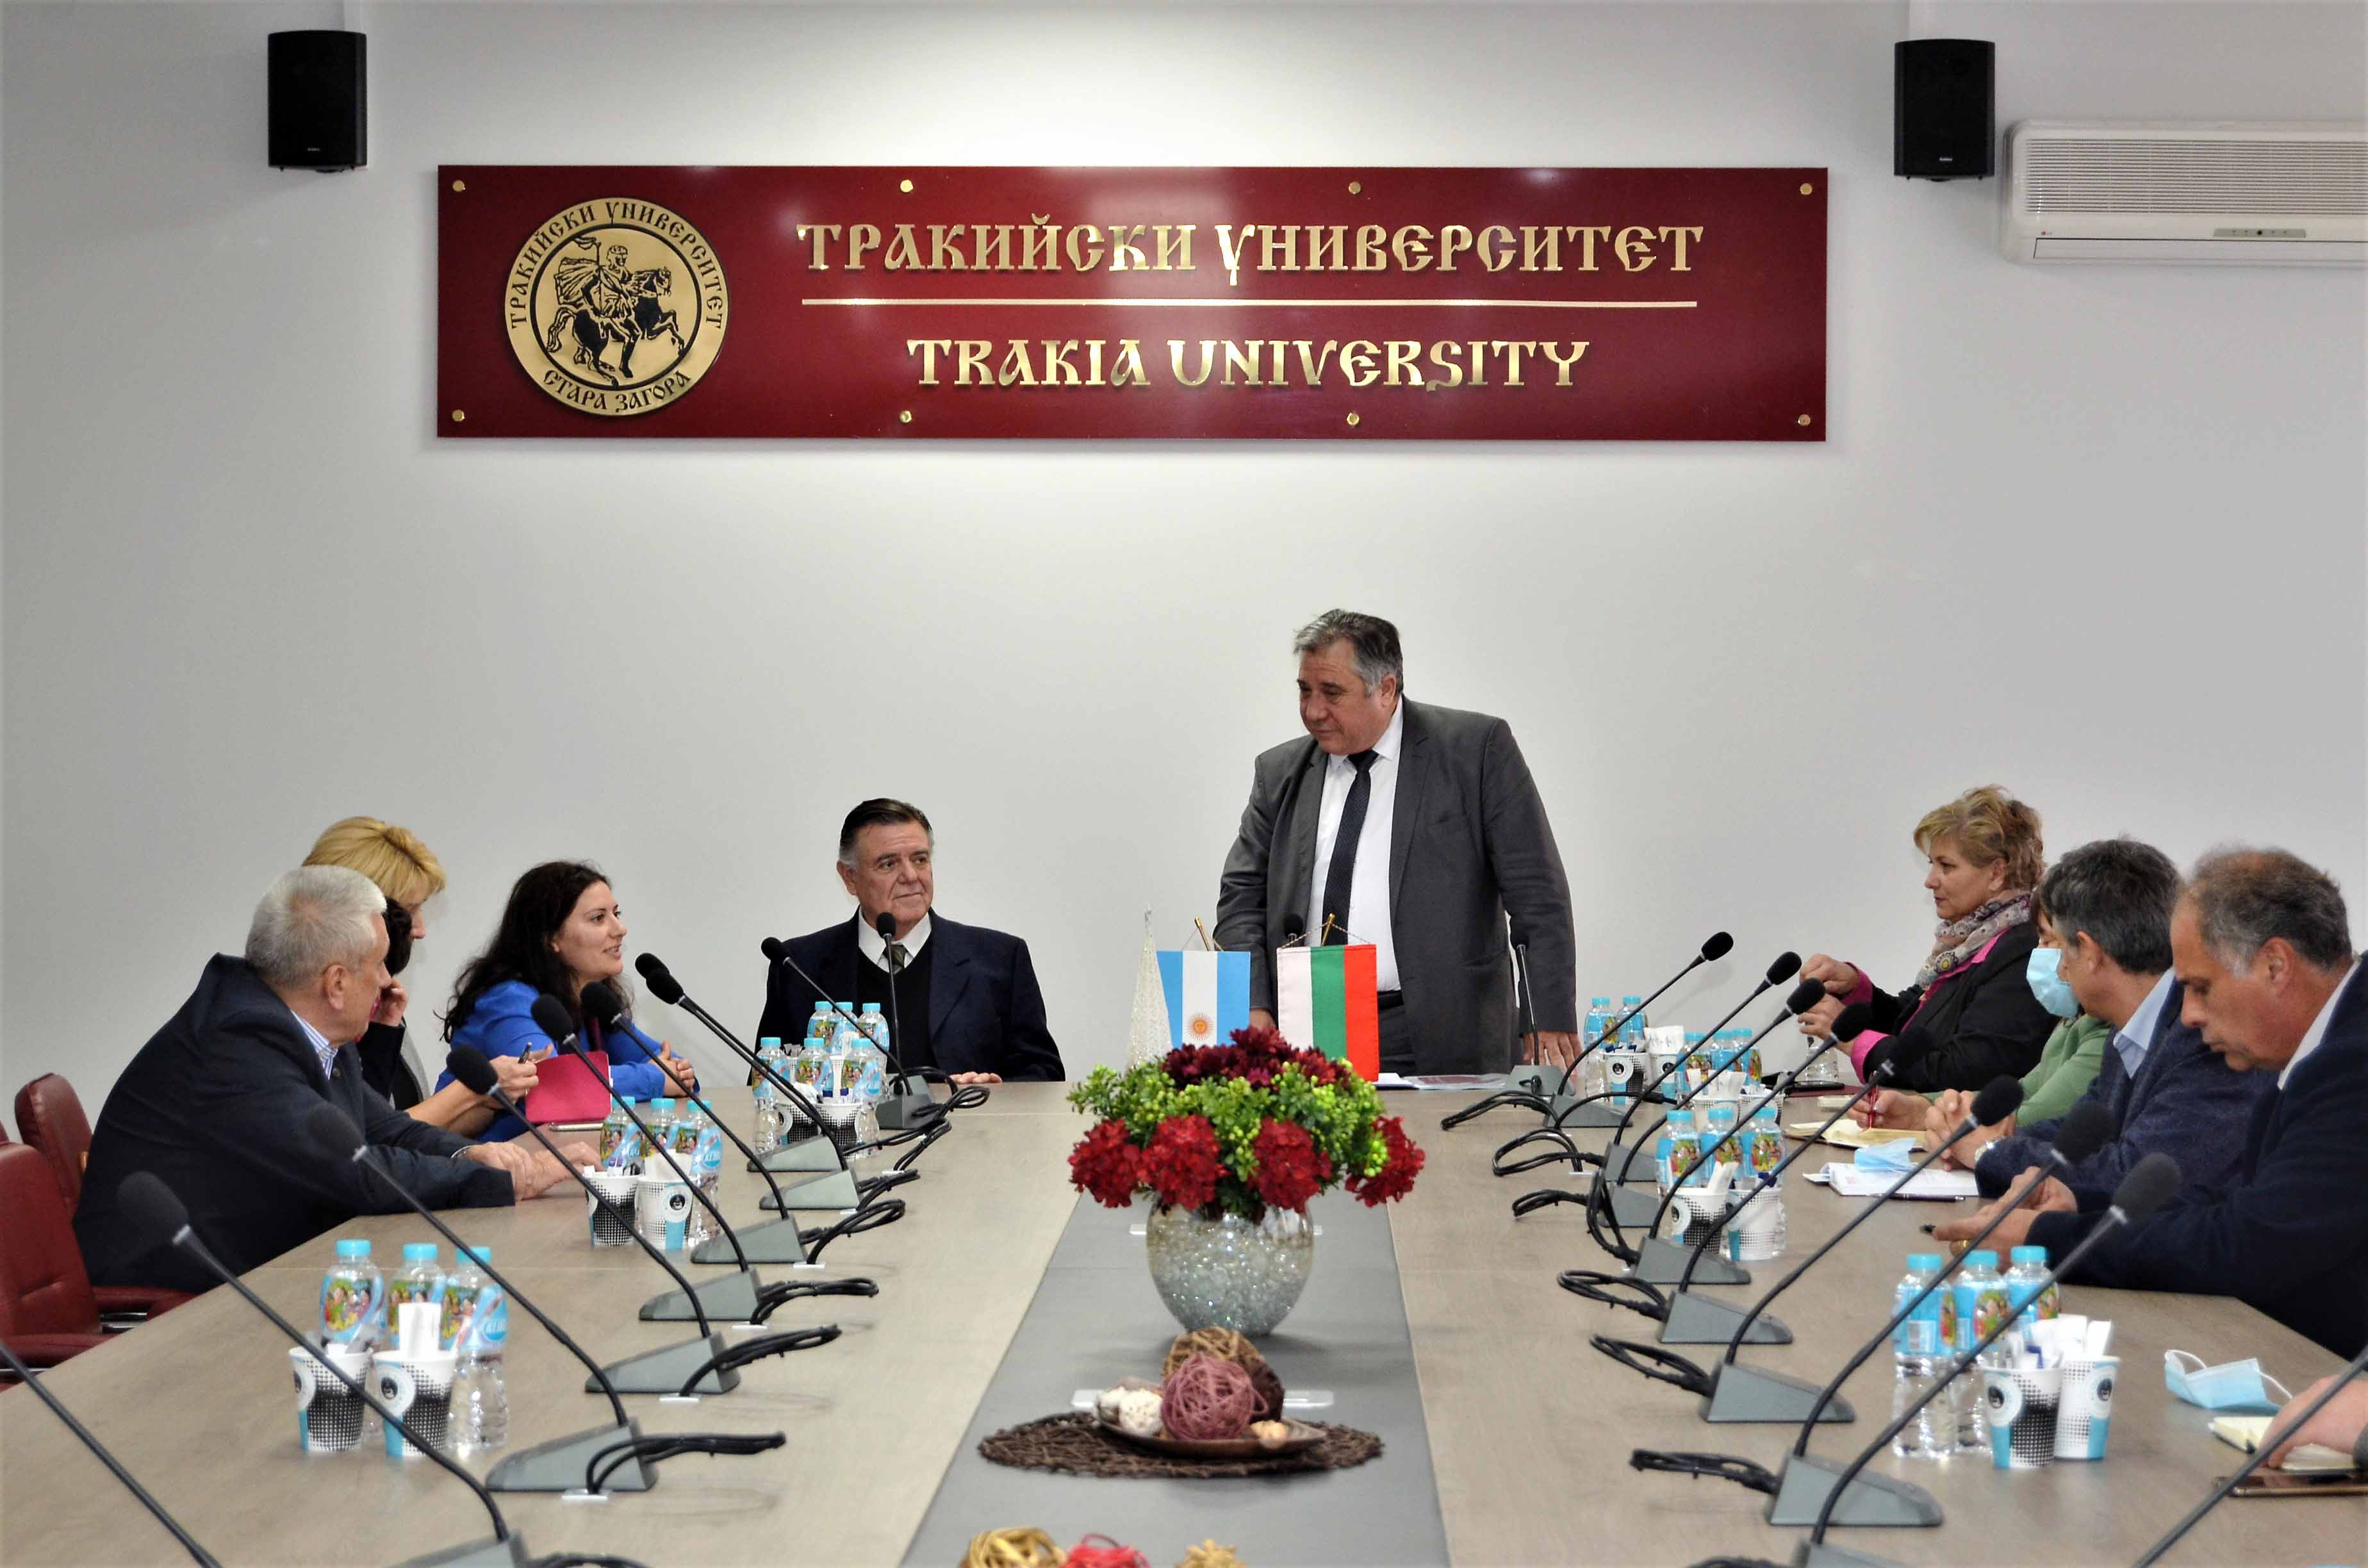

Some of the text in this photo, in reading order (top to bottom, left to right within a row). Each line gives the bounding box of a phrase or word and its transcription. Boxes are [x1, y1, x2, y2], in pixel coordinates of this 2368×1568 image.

[509, 201, 723, 329] ТРАКИЙСКИ УНИВЕРСИТЕТ
[796, 213, 1704, 286] ТРАКИЙСКИ УНИВЕРСИТЕТ
[543, 369, 692, 413] СТАРА ЗАГОРА
[907, 339, 1590, 392] TRAKIA UNIVERSITY
